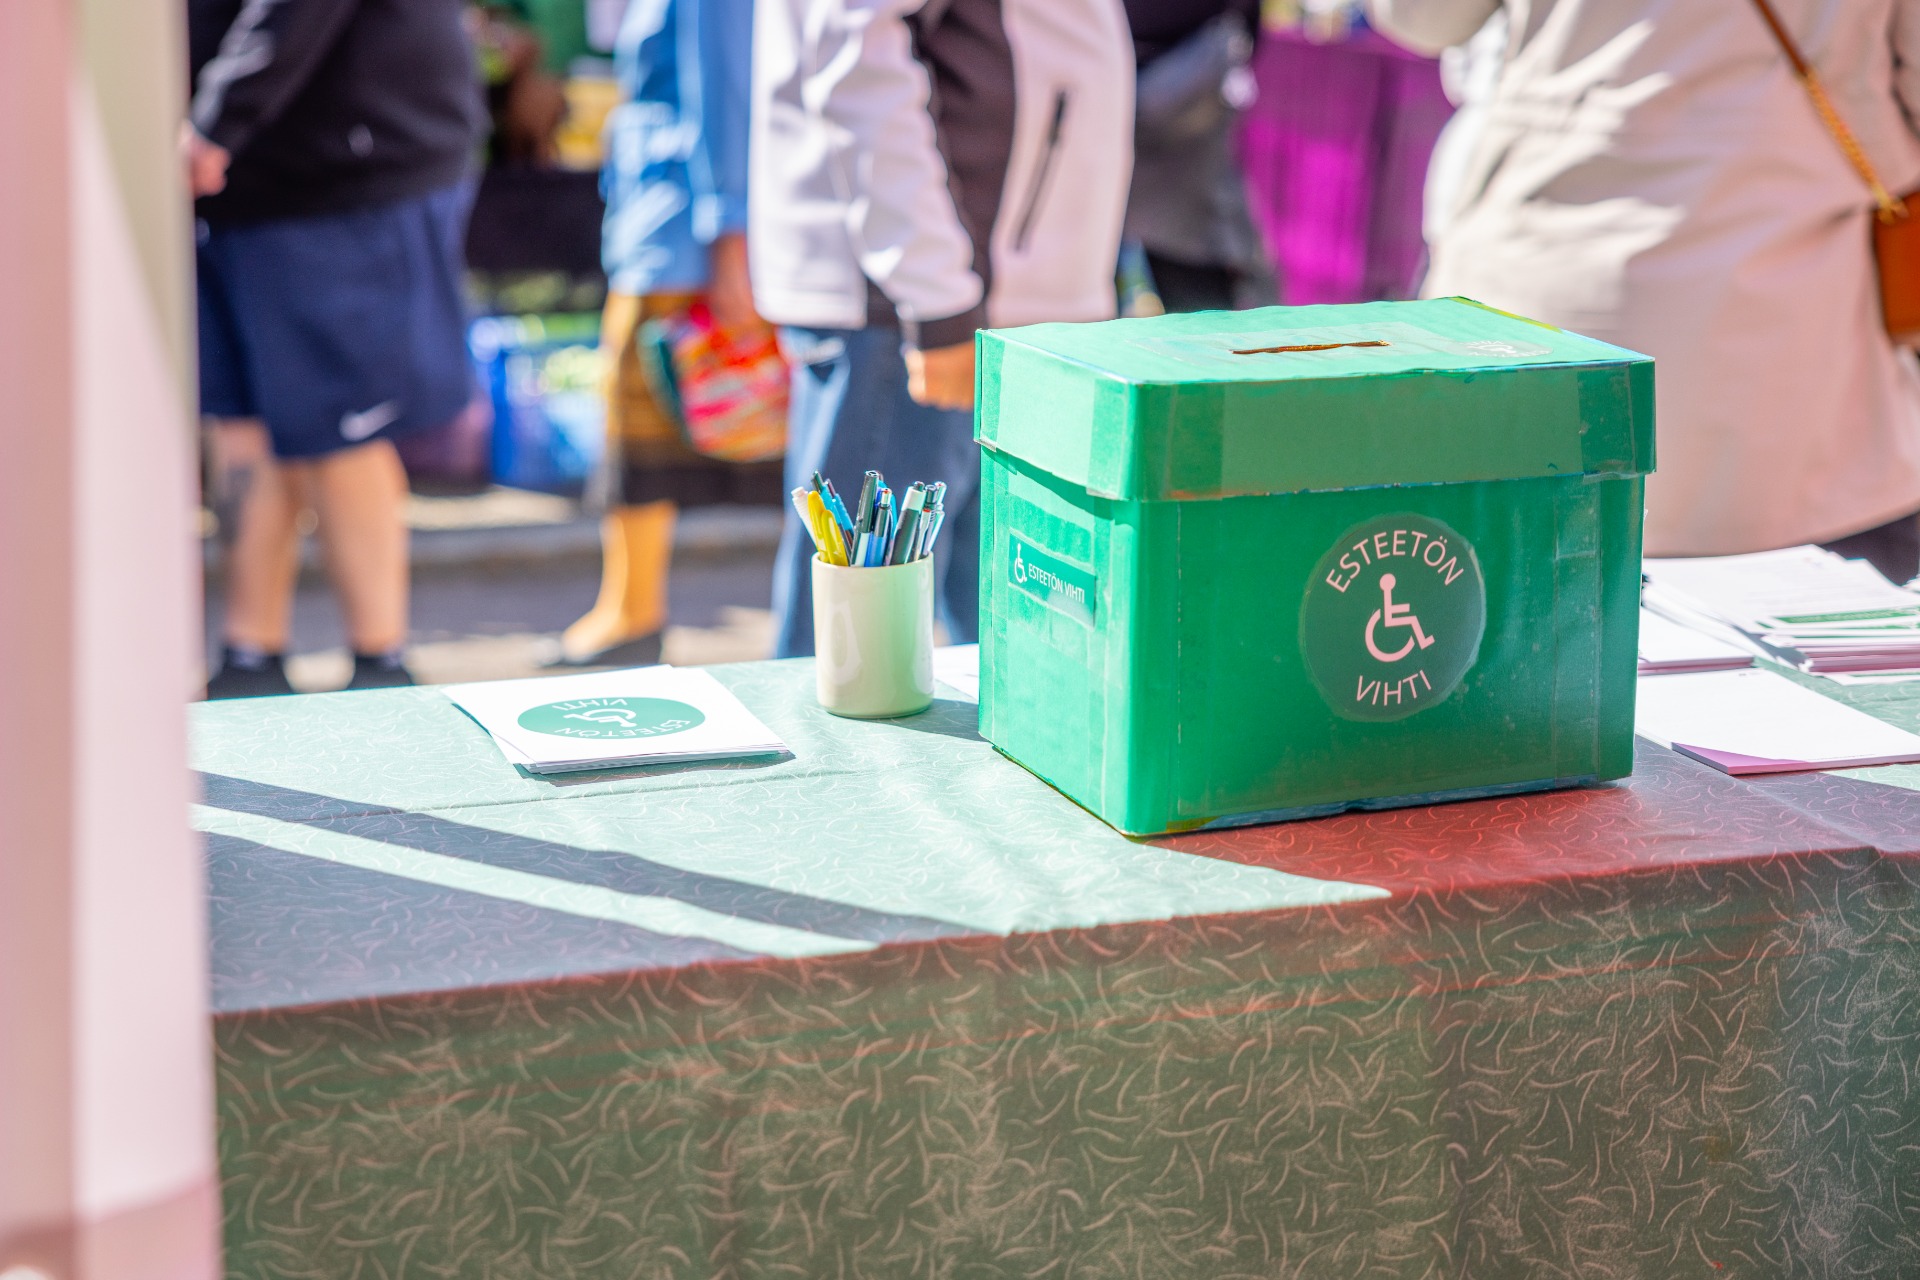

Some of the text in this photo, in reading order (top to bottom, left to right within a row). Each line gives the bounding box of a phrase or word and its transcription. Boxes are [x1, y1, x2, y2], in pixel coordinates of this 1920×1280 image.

[1325, 530, 1464, 593] ESTEETÖN
[1028, 563, 1085, 604] ESTEETÖN VIHTI
[552, 699, 628, 711] VIHTI
[1356, 669, 1432, 706] VIHTI
